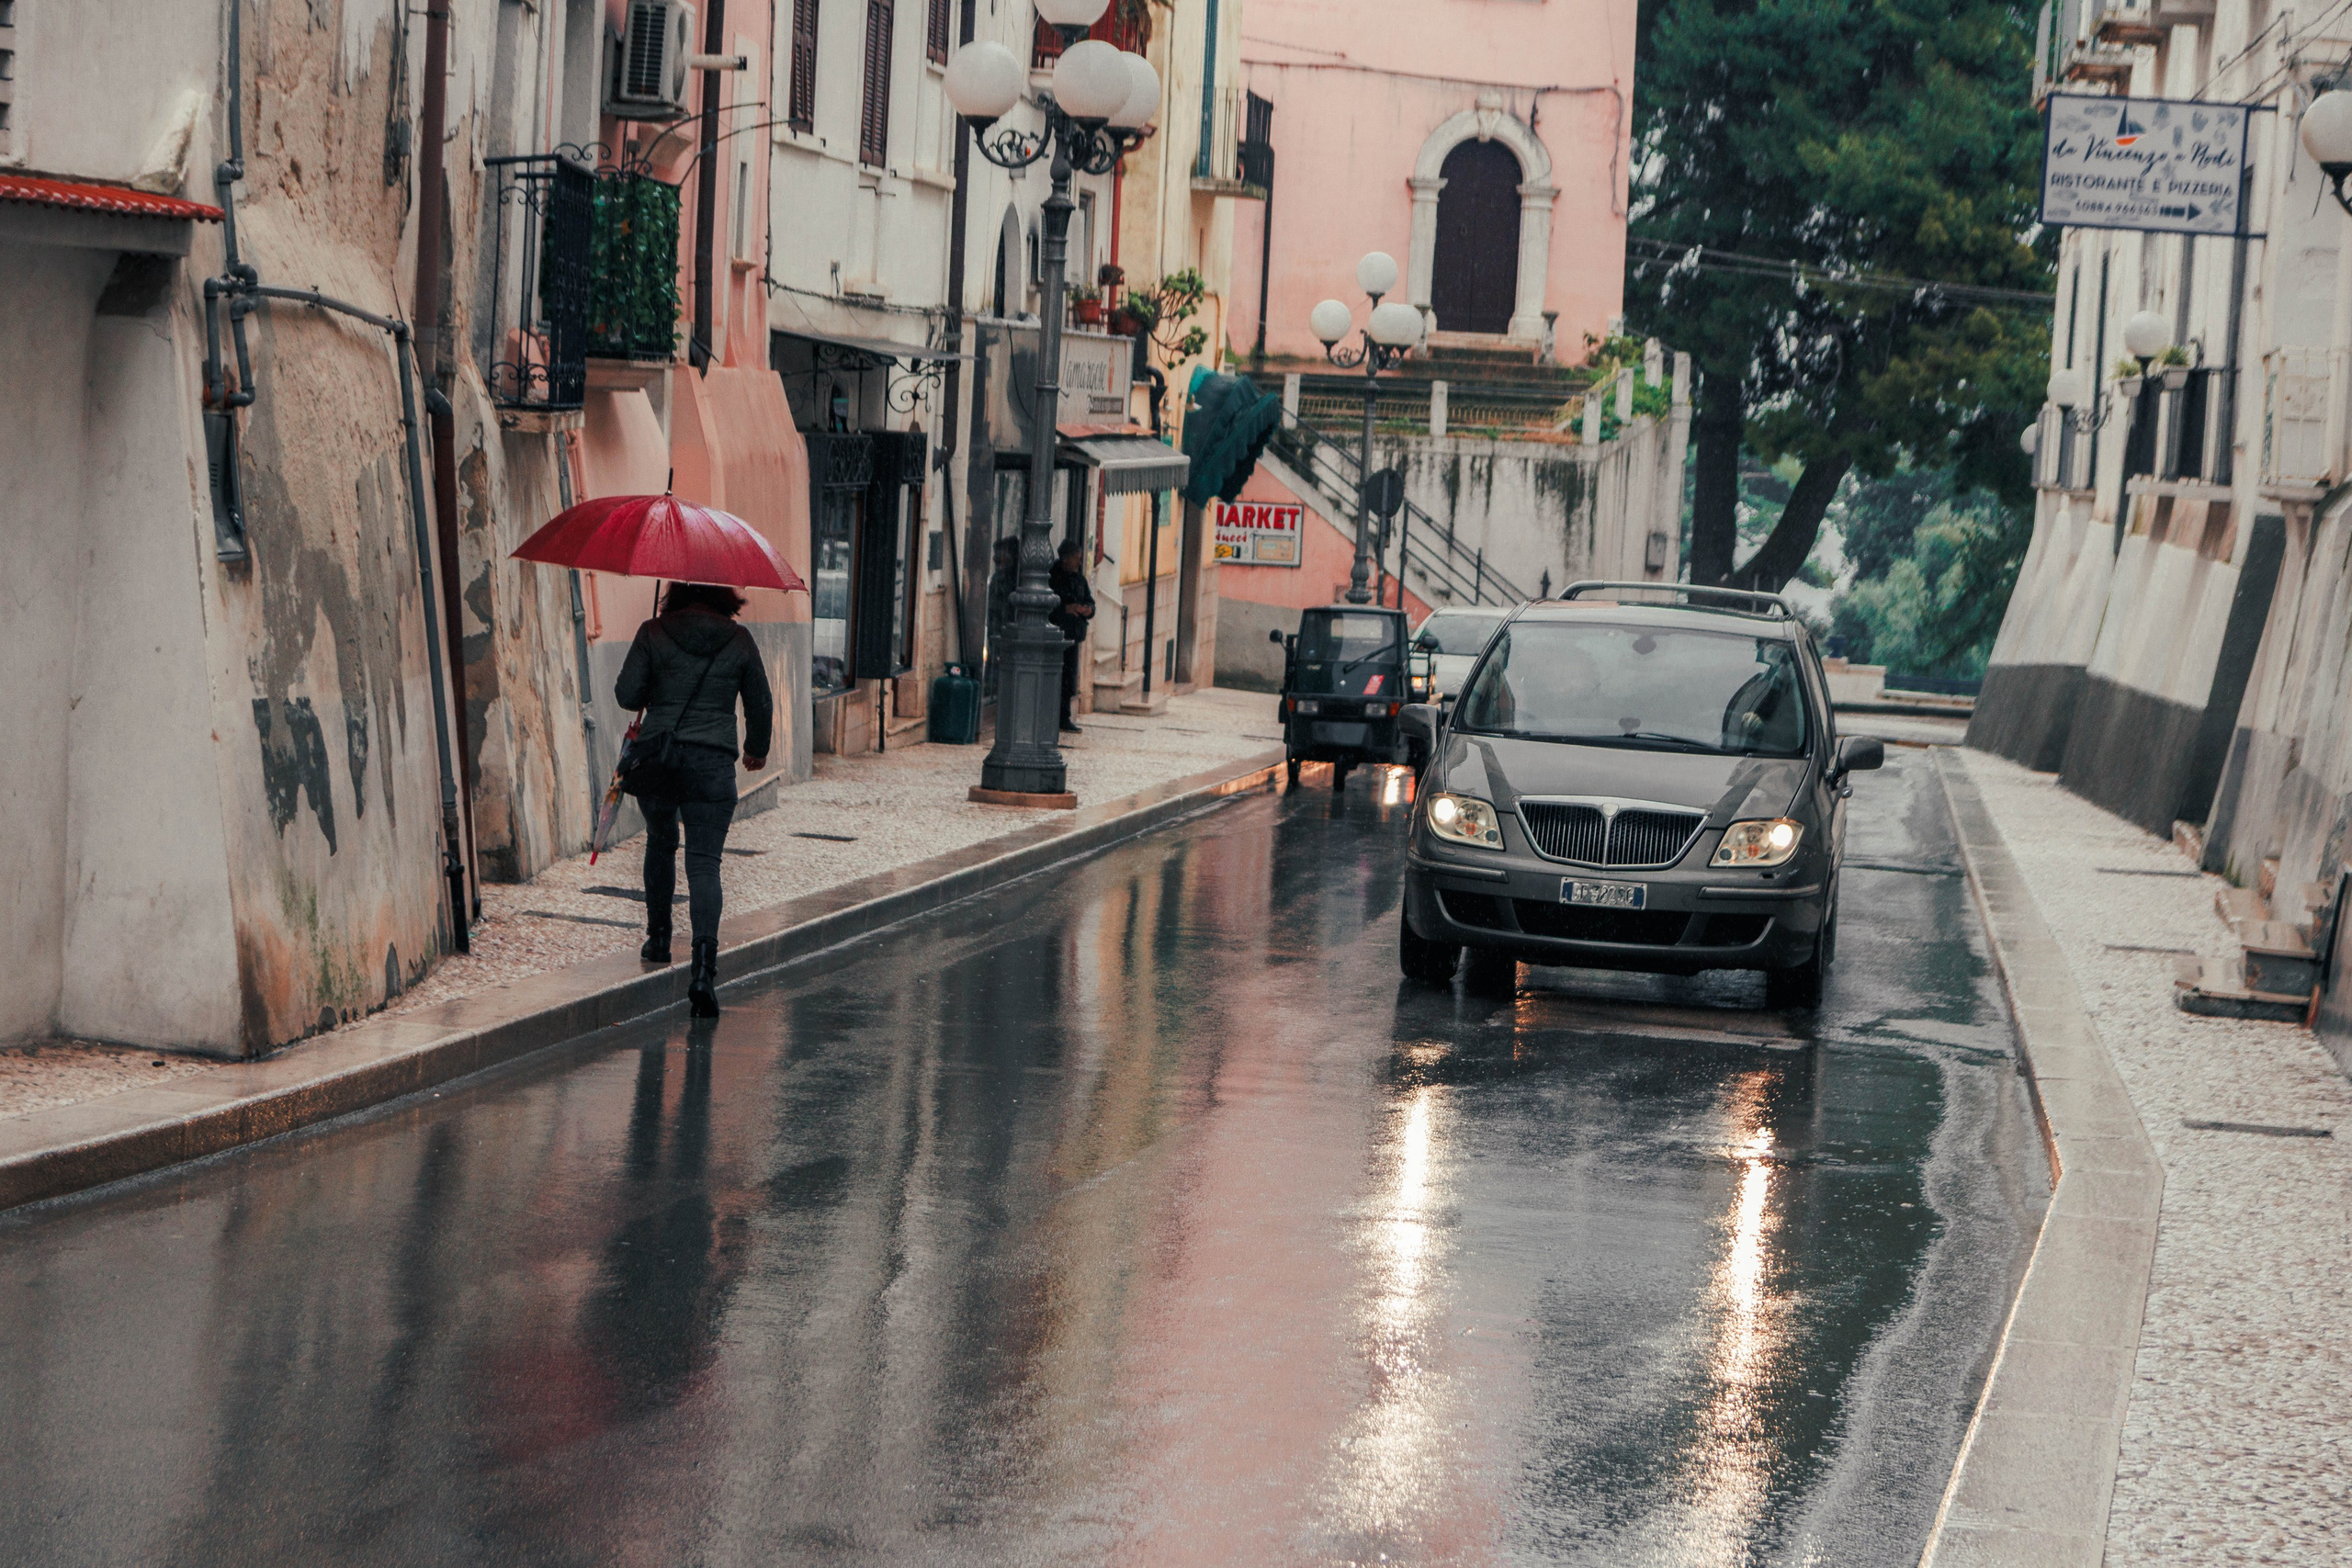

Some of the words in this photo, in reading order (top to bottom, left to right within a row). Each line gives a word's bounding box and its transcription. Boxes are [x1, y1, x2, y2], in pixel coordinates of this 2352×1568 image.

[2084, 133, 2167, 176] Vincenzo
[2051, 172, 2144, 193] RISTORANTE
[2153, 177, 2161, 194] E
[2168, 179, 2233, 198] PIZZERIA
